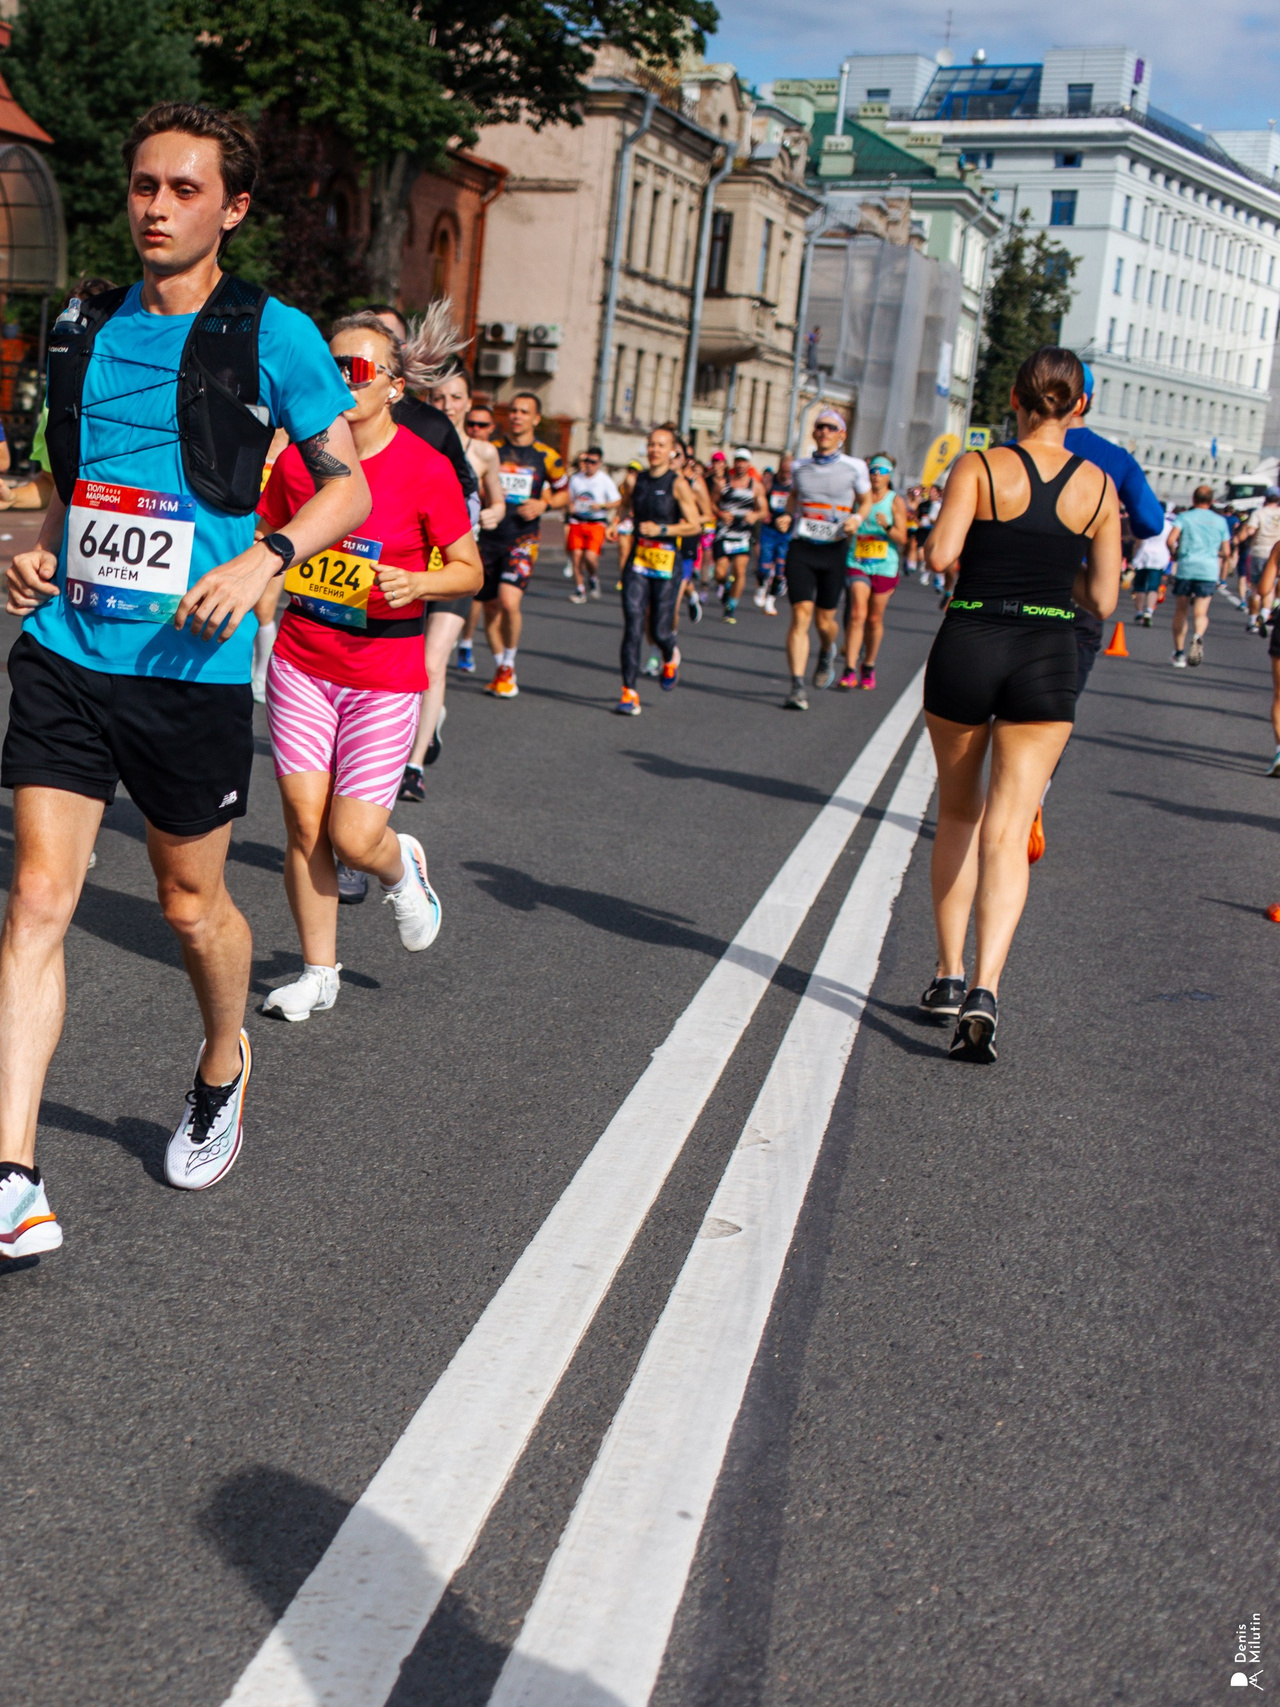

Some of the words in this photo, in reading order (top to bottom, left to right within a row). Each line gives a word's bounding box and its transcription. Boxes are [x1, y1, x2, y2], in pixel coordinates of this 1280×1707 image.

[87, 483, 106, 493] ПОЛУ
[86, 492, 121, 504] МАРАФОН
[137, 497, 157, 511] 21,1
[79, 520, 173, 570] 6402
[342, 540, 355, 550] 21,1
[97, 566, 139, 581] АРТЁМ
[299, 556, 361, 591] 6124
[72, 583, 84, 604] D
[309, 583, 345, 599] ЕВГЕНИЯ
